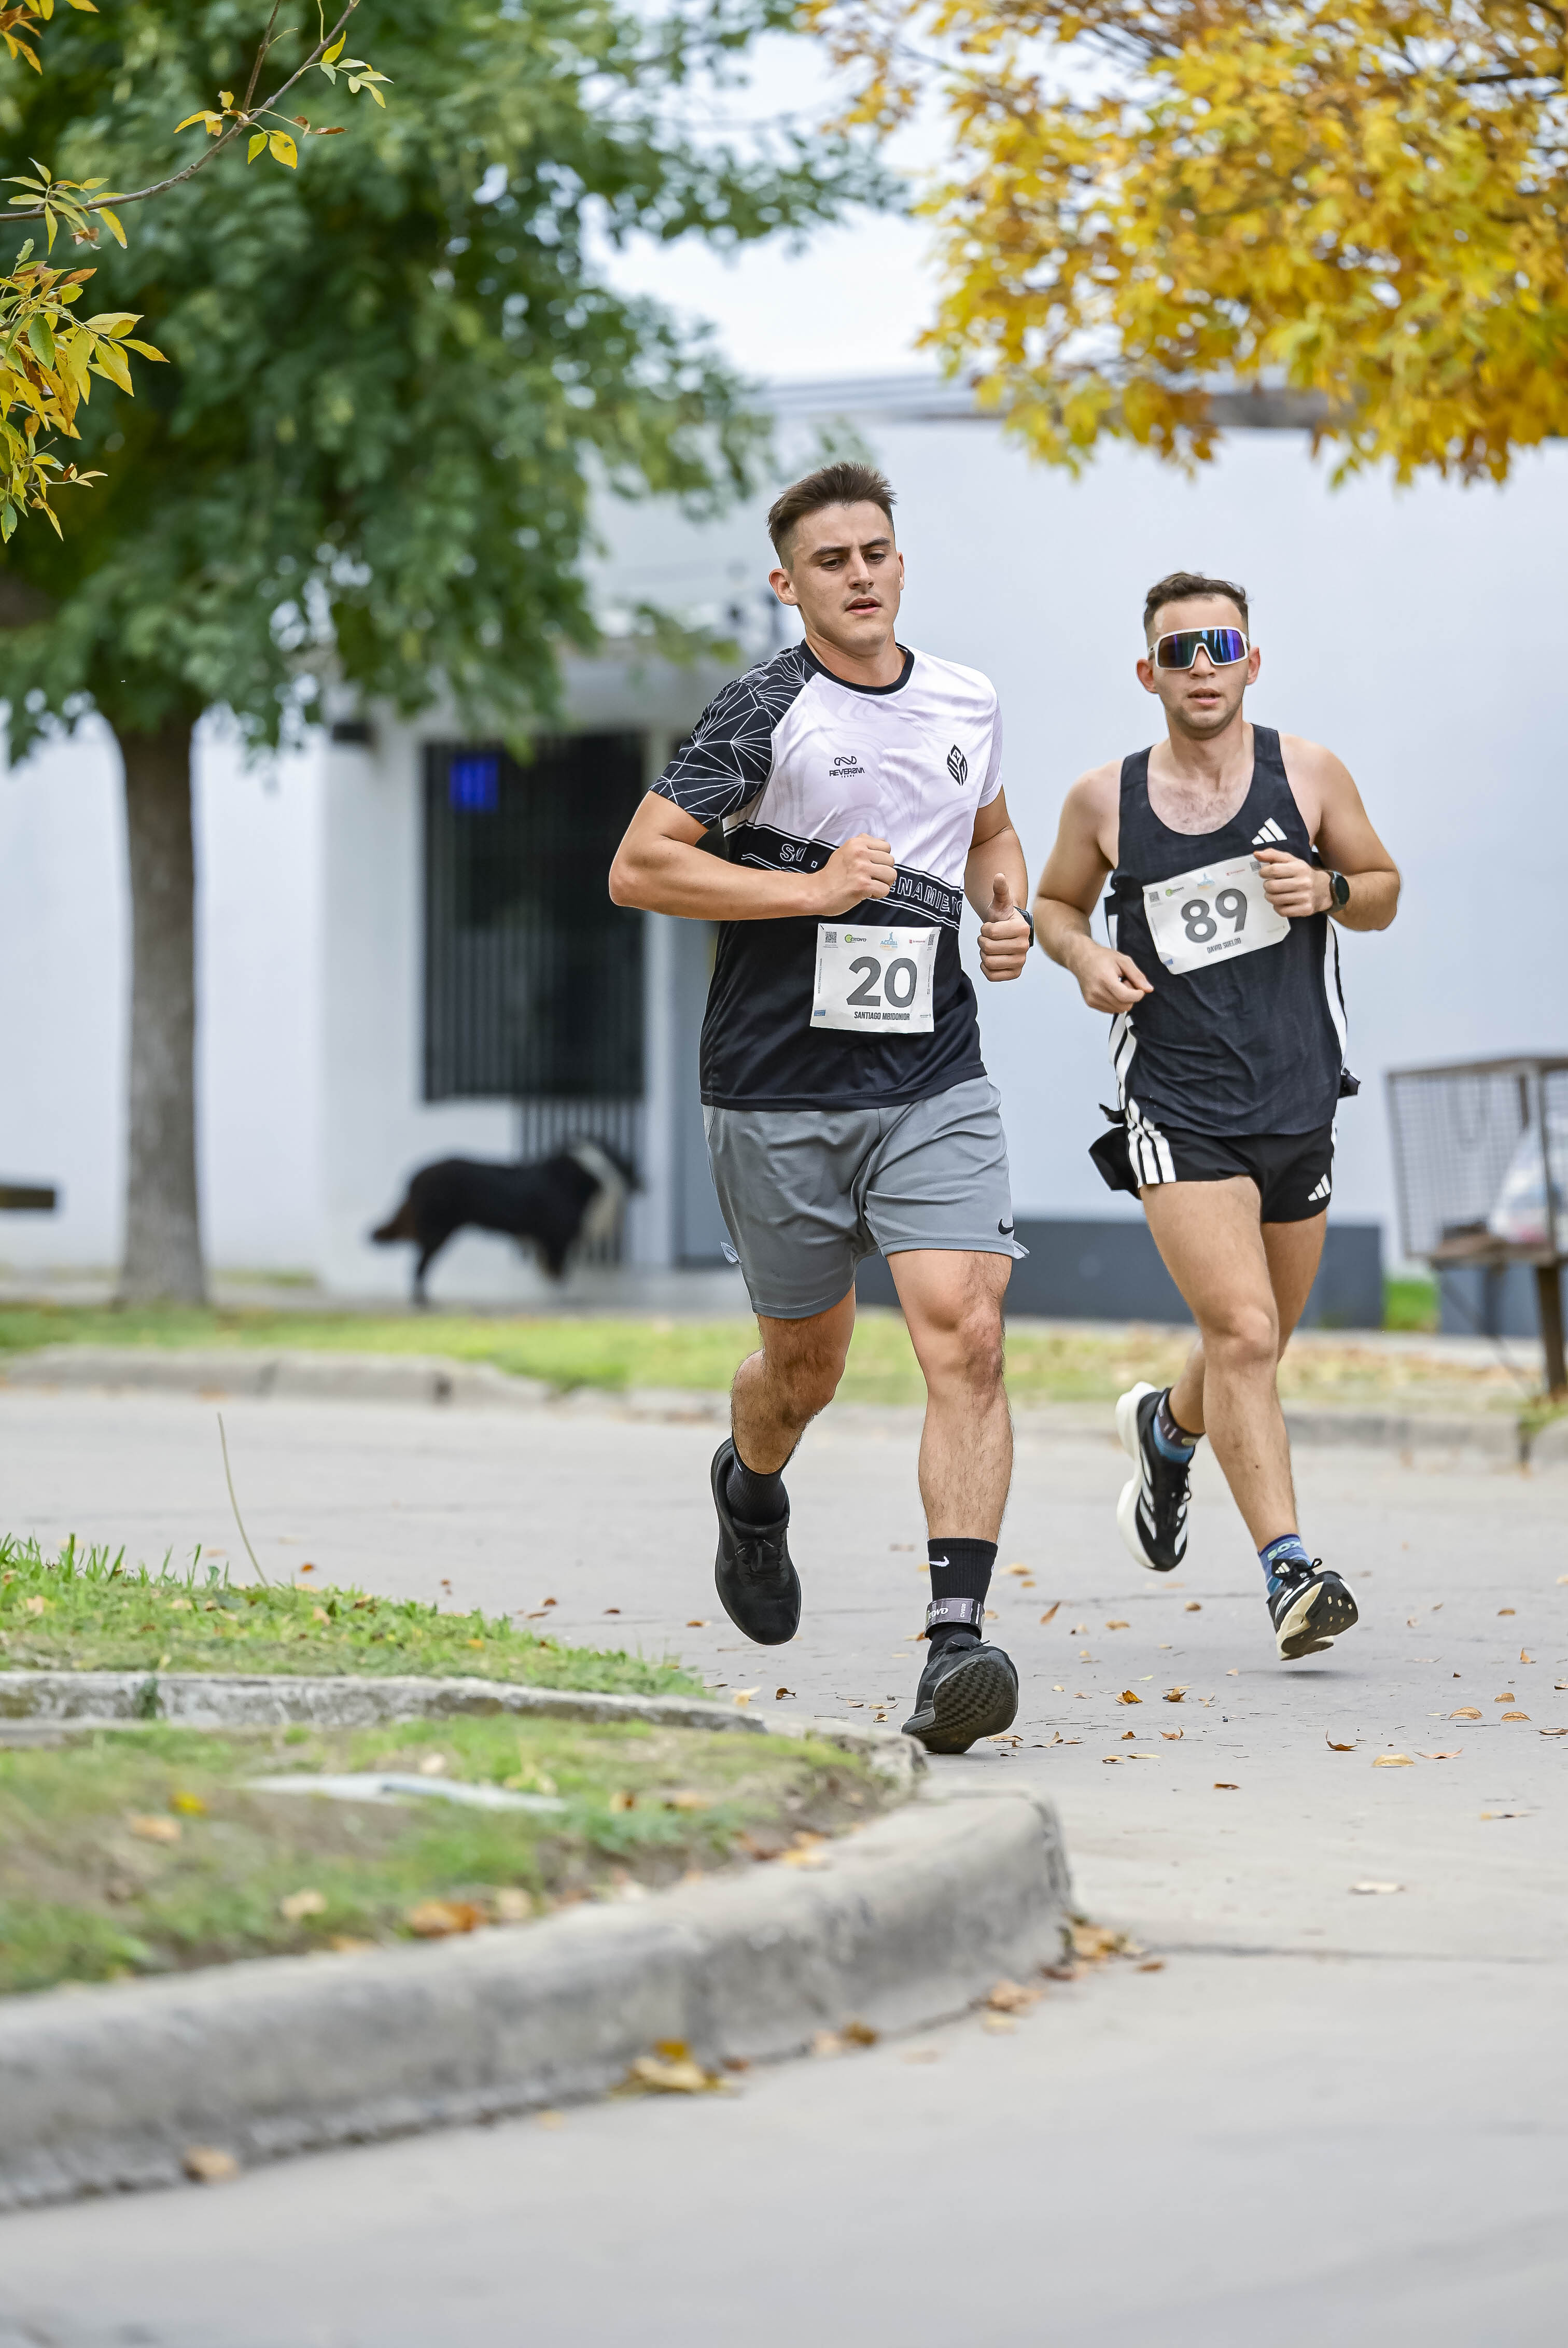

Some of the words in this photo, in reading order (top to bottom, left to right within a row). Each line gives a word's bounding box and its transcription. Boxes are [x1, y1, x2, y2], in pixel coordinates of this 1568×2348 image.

[1180, 888, 1248, 943] 89
[1207, 944, 1222, 954] DAVID
[1222, 938, 1242, 949] SUELDO
[846, 956, 917, 1008] 20
[854, 1011, 881, 1020] SANTIAGO
